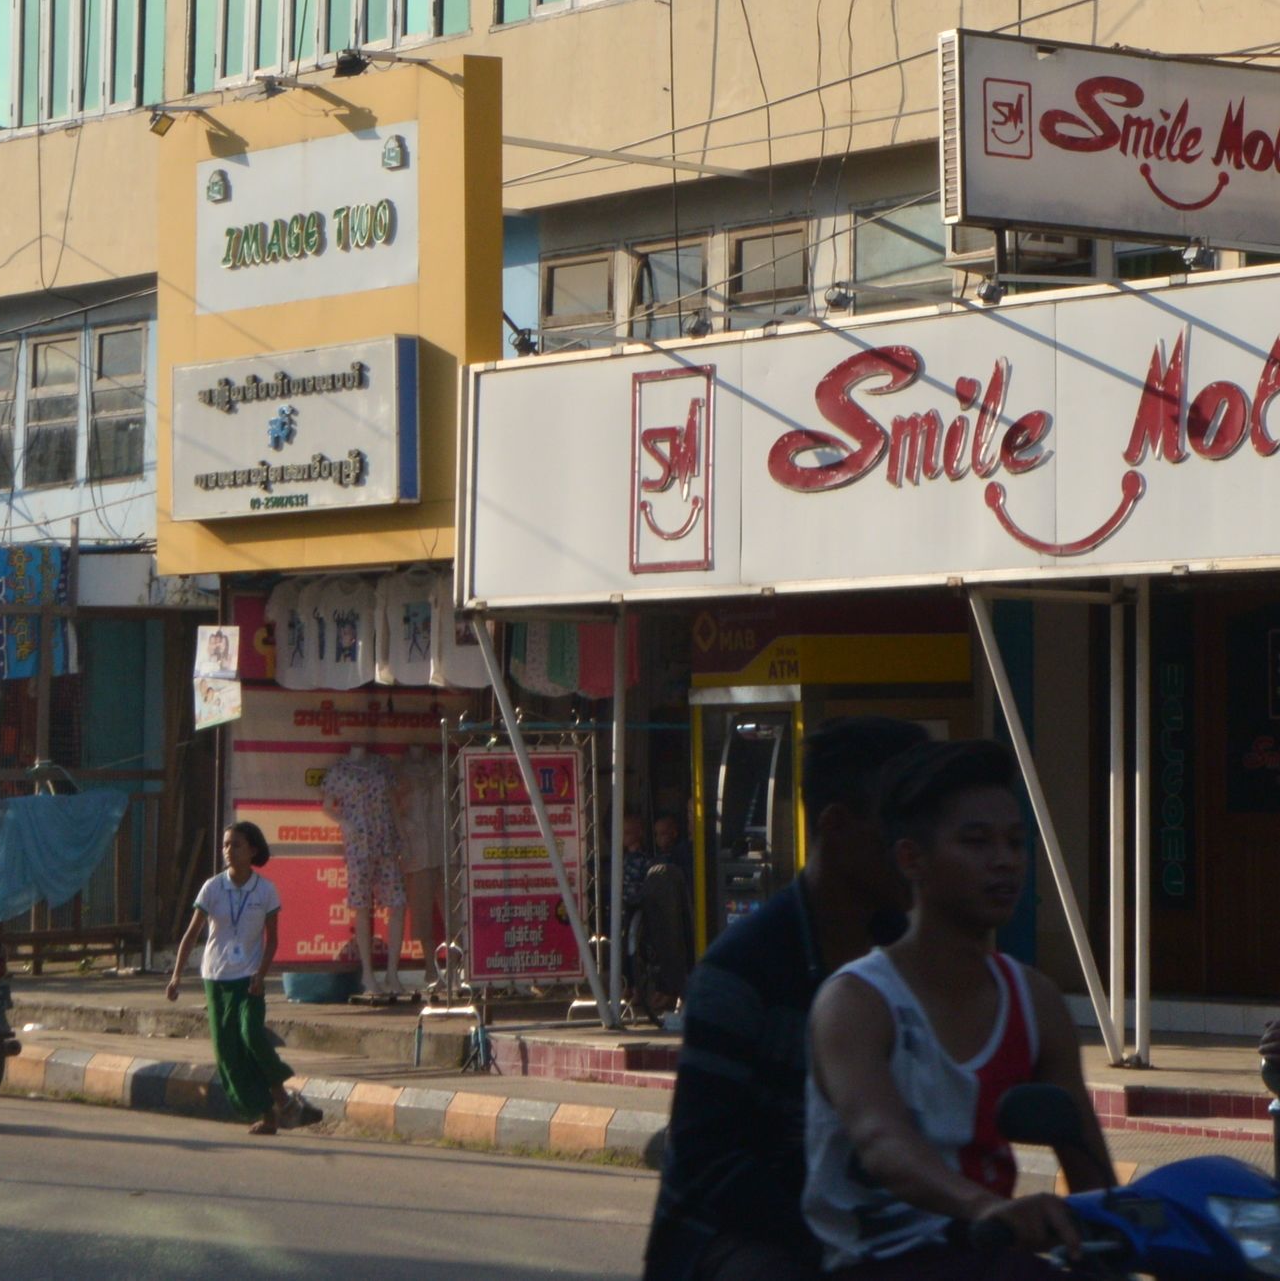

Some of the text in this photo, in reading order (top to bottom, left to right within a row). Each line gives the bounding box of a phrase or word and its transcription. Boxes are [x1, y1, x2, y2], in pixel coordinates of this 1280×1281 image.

[1039, 74, 1202, 166] Smile
[221, 198, 391, 268] IMAGE TWO
[766, 345, 1053, 492] Smile
[768, 660, 800, 680] ATM
